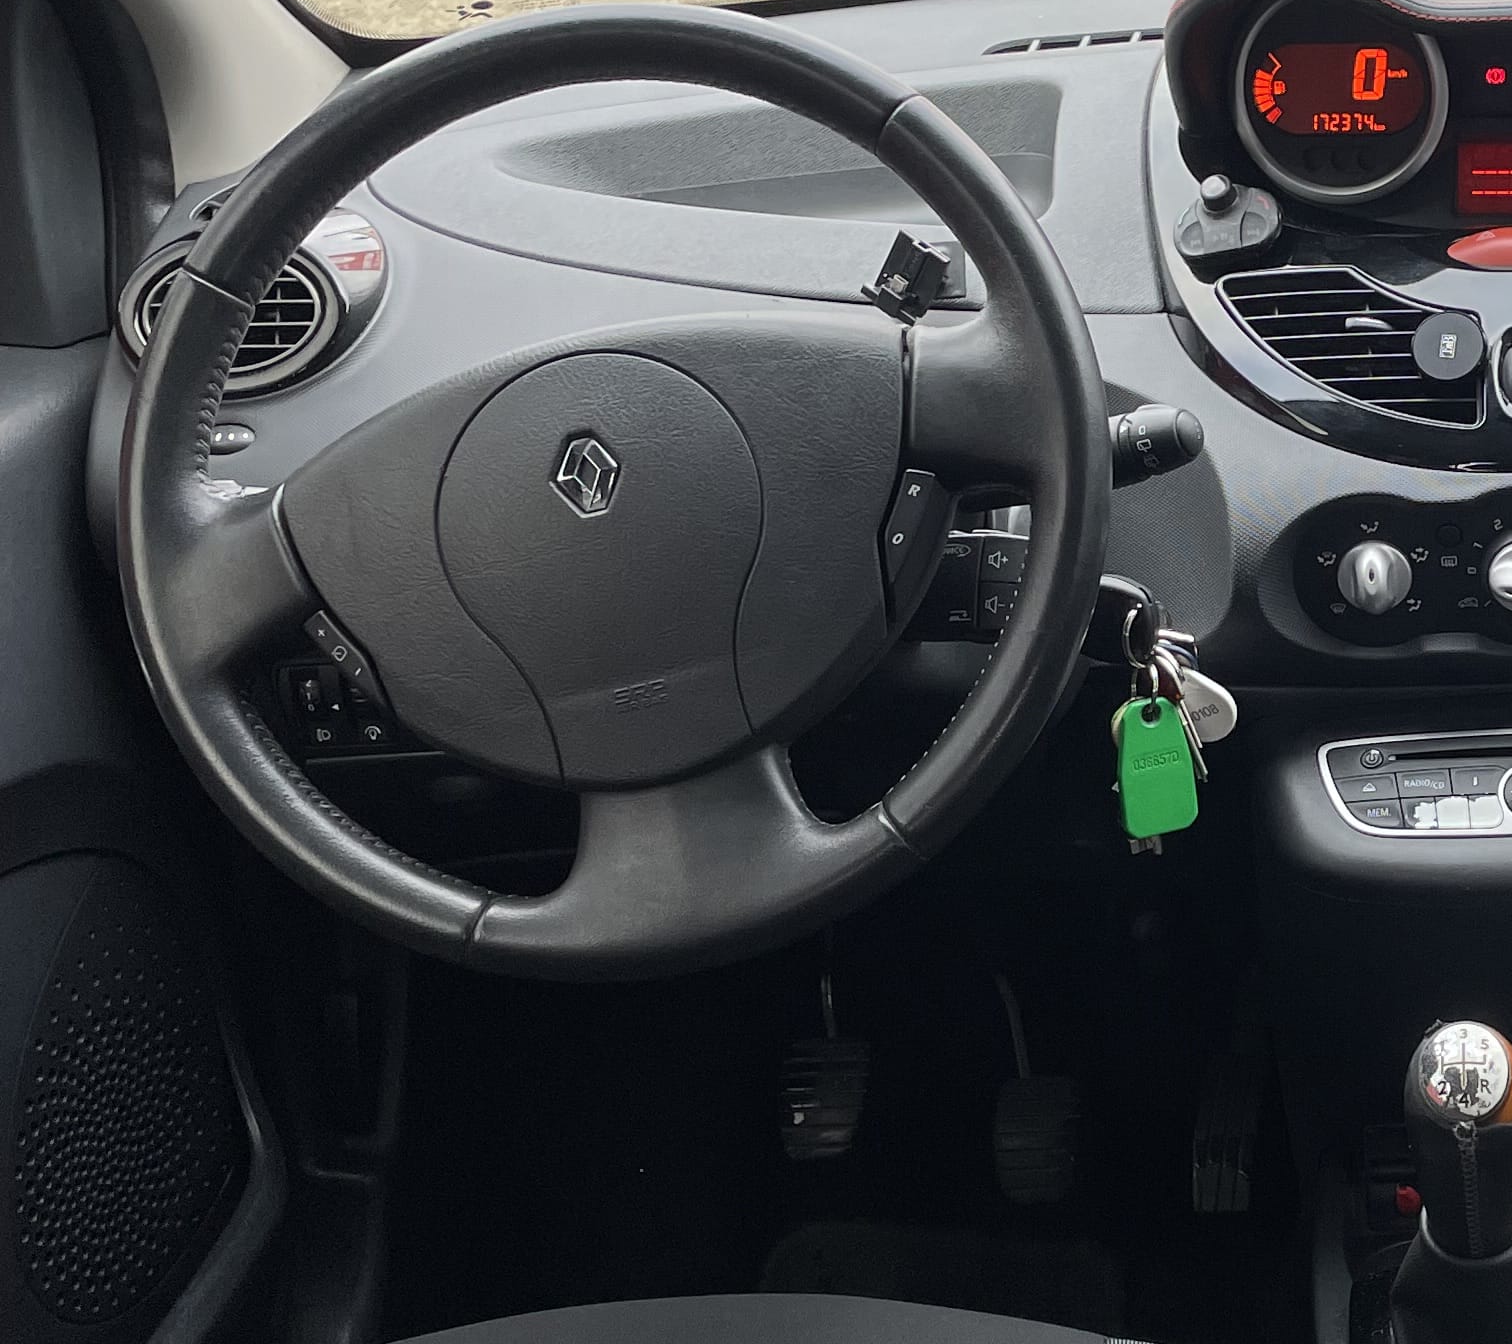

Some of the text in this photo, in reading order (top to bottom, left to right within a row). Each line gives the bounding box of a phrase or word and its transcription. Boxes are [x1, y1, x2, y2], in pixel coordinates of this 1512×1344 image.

[1352, 48, 1388, 101] 0
[1313, 112, 1374, 132] 172374
[907, 483, 921, 497] R
[1492, 519, 1504, 531] 2
[1403, 778, 1446, 790] RADIO/CD
[1459, 1028, 1468, 1039] 3
[1437, 1081, 1448, 1096] 2
[1480, 1078, 1492, 1095] R
[1459, 1092, 1470, 1109] 4
